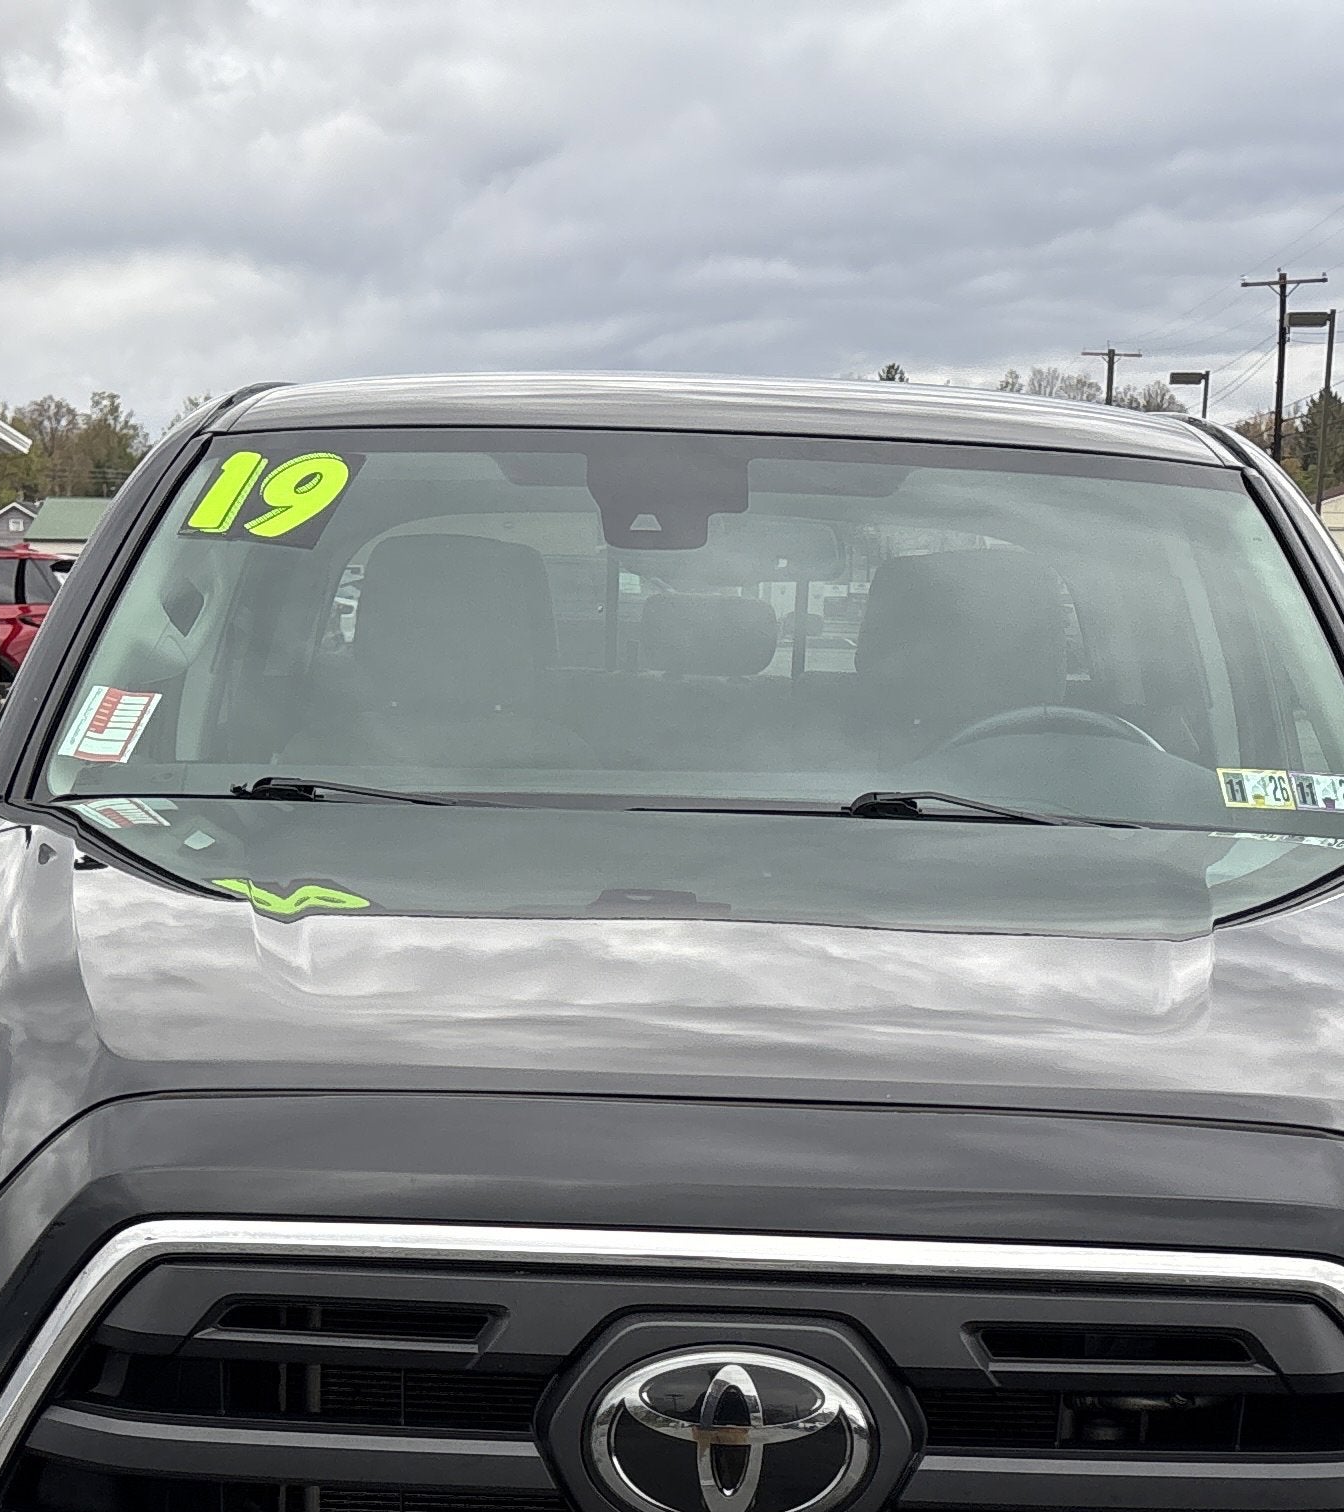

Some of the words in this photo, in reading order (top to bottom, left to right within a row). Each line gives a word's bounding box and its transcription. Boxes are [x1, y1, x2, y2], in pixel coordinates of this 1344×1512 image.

[188, 451, 349, 538] 19
[1225, 778, 1249, 803] 11
[1268, 775, 1291, 802] 26
[1296, 781, 1319, 806] 11
